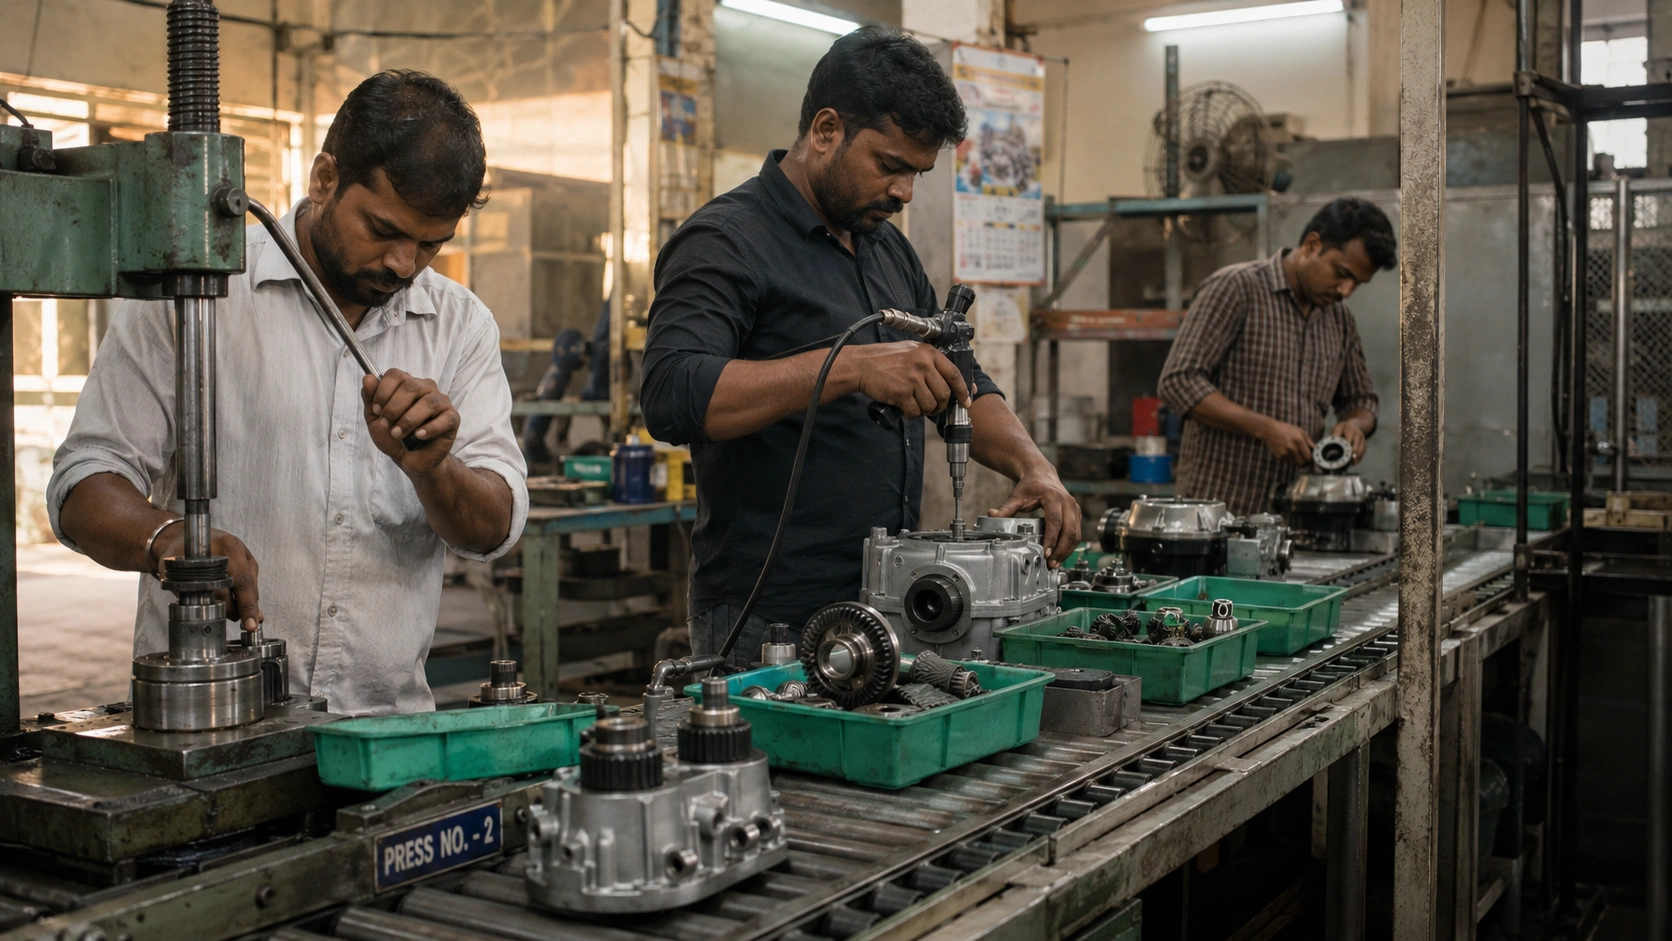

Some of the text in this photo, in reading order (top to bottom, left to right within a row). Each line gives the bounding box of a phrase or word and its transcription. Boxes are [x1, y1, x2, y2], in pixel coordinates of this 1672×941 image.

[384, 815, 494, 876] PRESS NO. - 2
